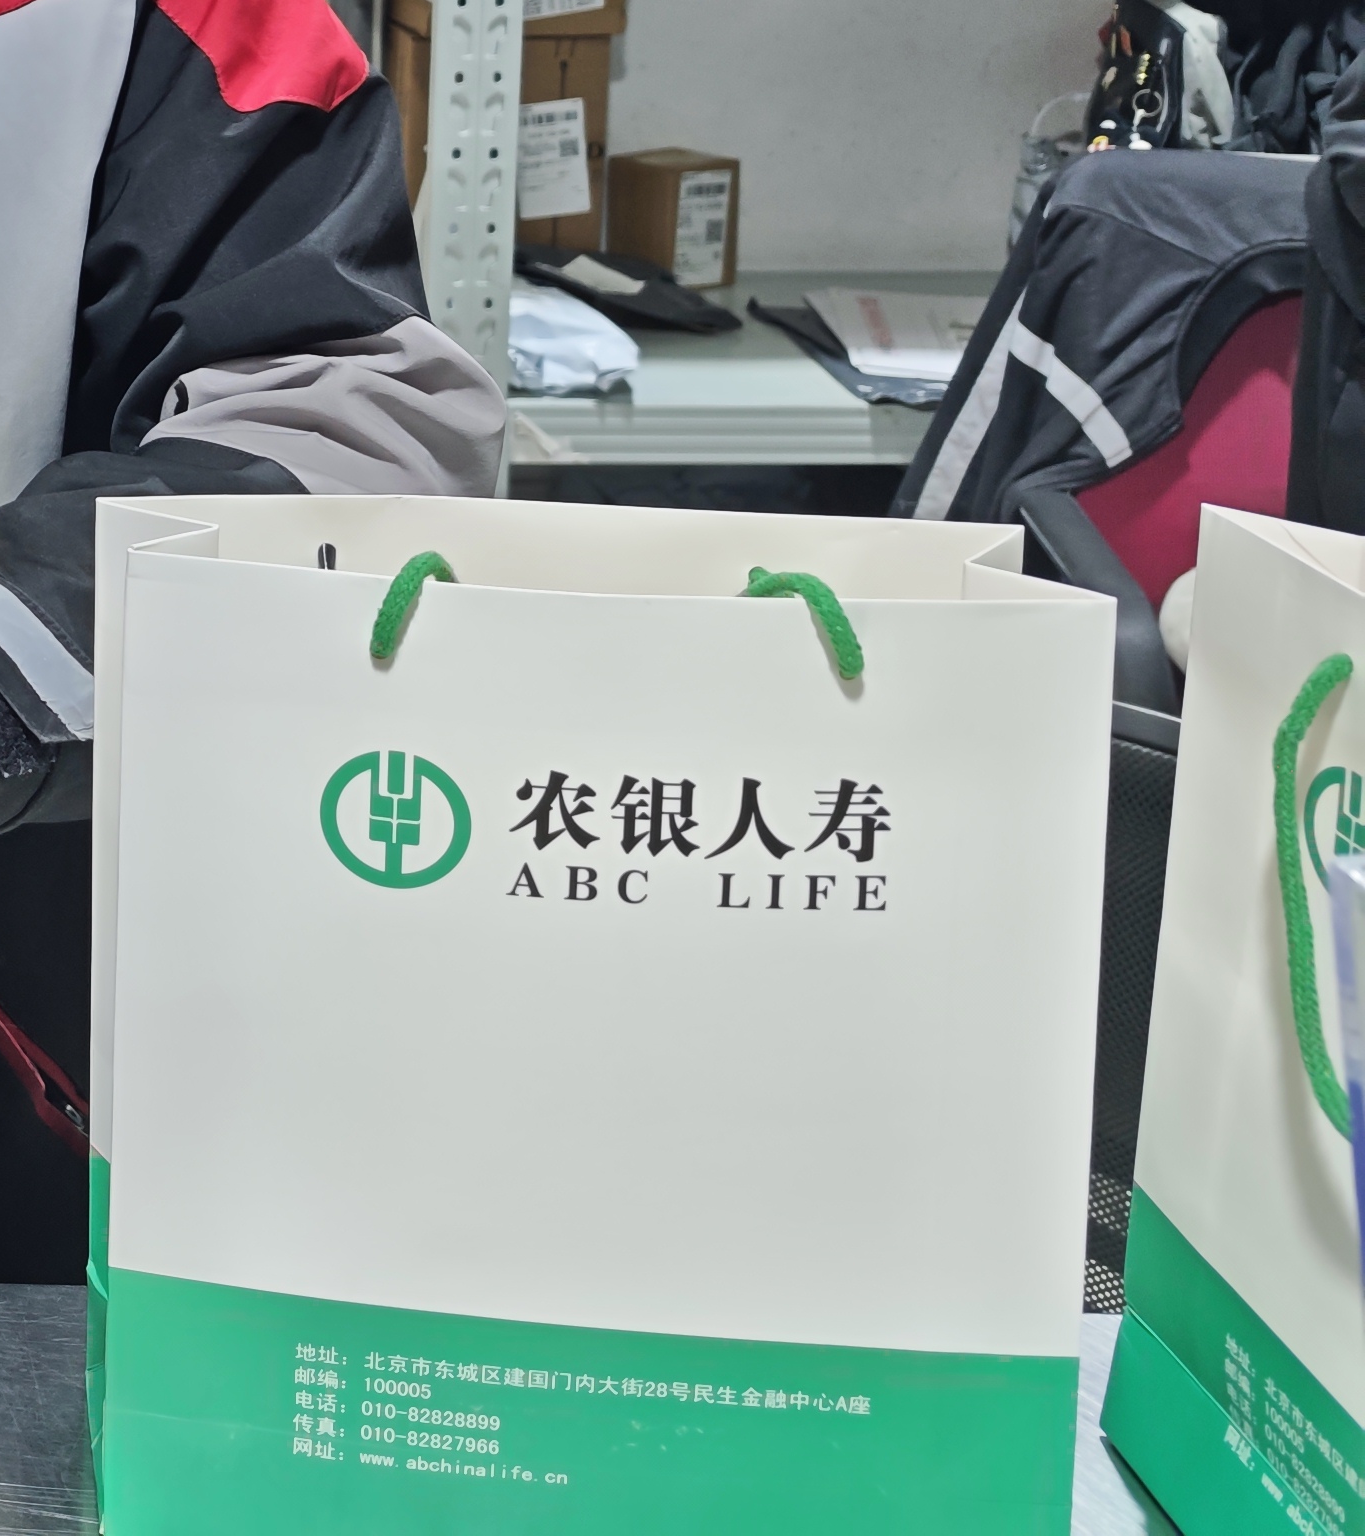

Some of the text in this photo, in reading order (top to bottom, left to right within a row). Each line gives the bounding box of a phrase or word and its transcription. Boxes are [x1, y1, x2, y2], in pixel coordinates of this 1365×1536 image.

[508, 769, 892, 863] 农银人寿
[505, 863, 888, 913] ABC LIFE
[294, 1365, 432, 1400] 邮编： 100005
[295, 1343, 871, 1415] 地址： 北京市东城区建国门内大街28号民生金融中心A座
[292, 1412, 500, 1455] 传真： 010-82827966
[295, 1389, 501, 1431] 电话： 010-82828899
[1265, 1401, 1305, 1454] 100005
[292, 1437, 568, 1486] 网址： www.abchinalife.cn
